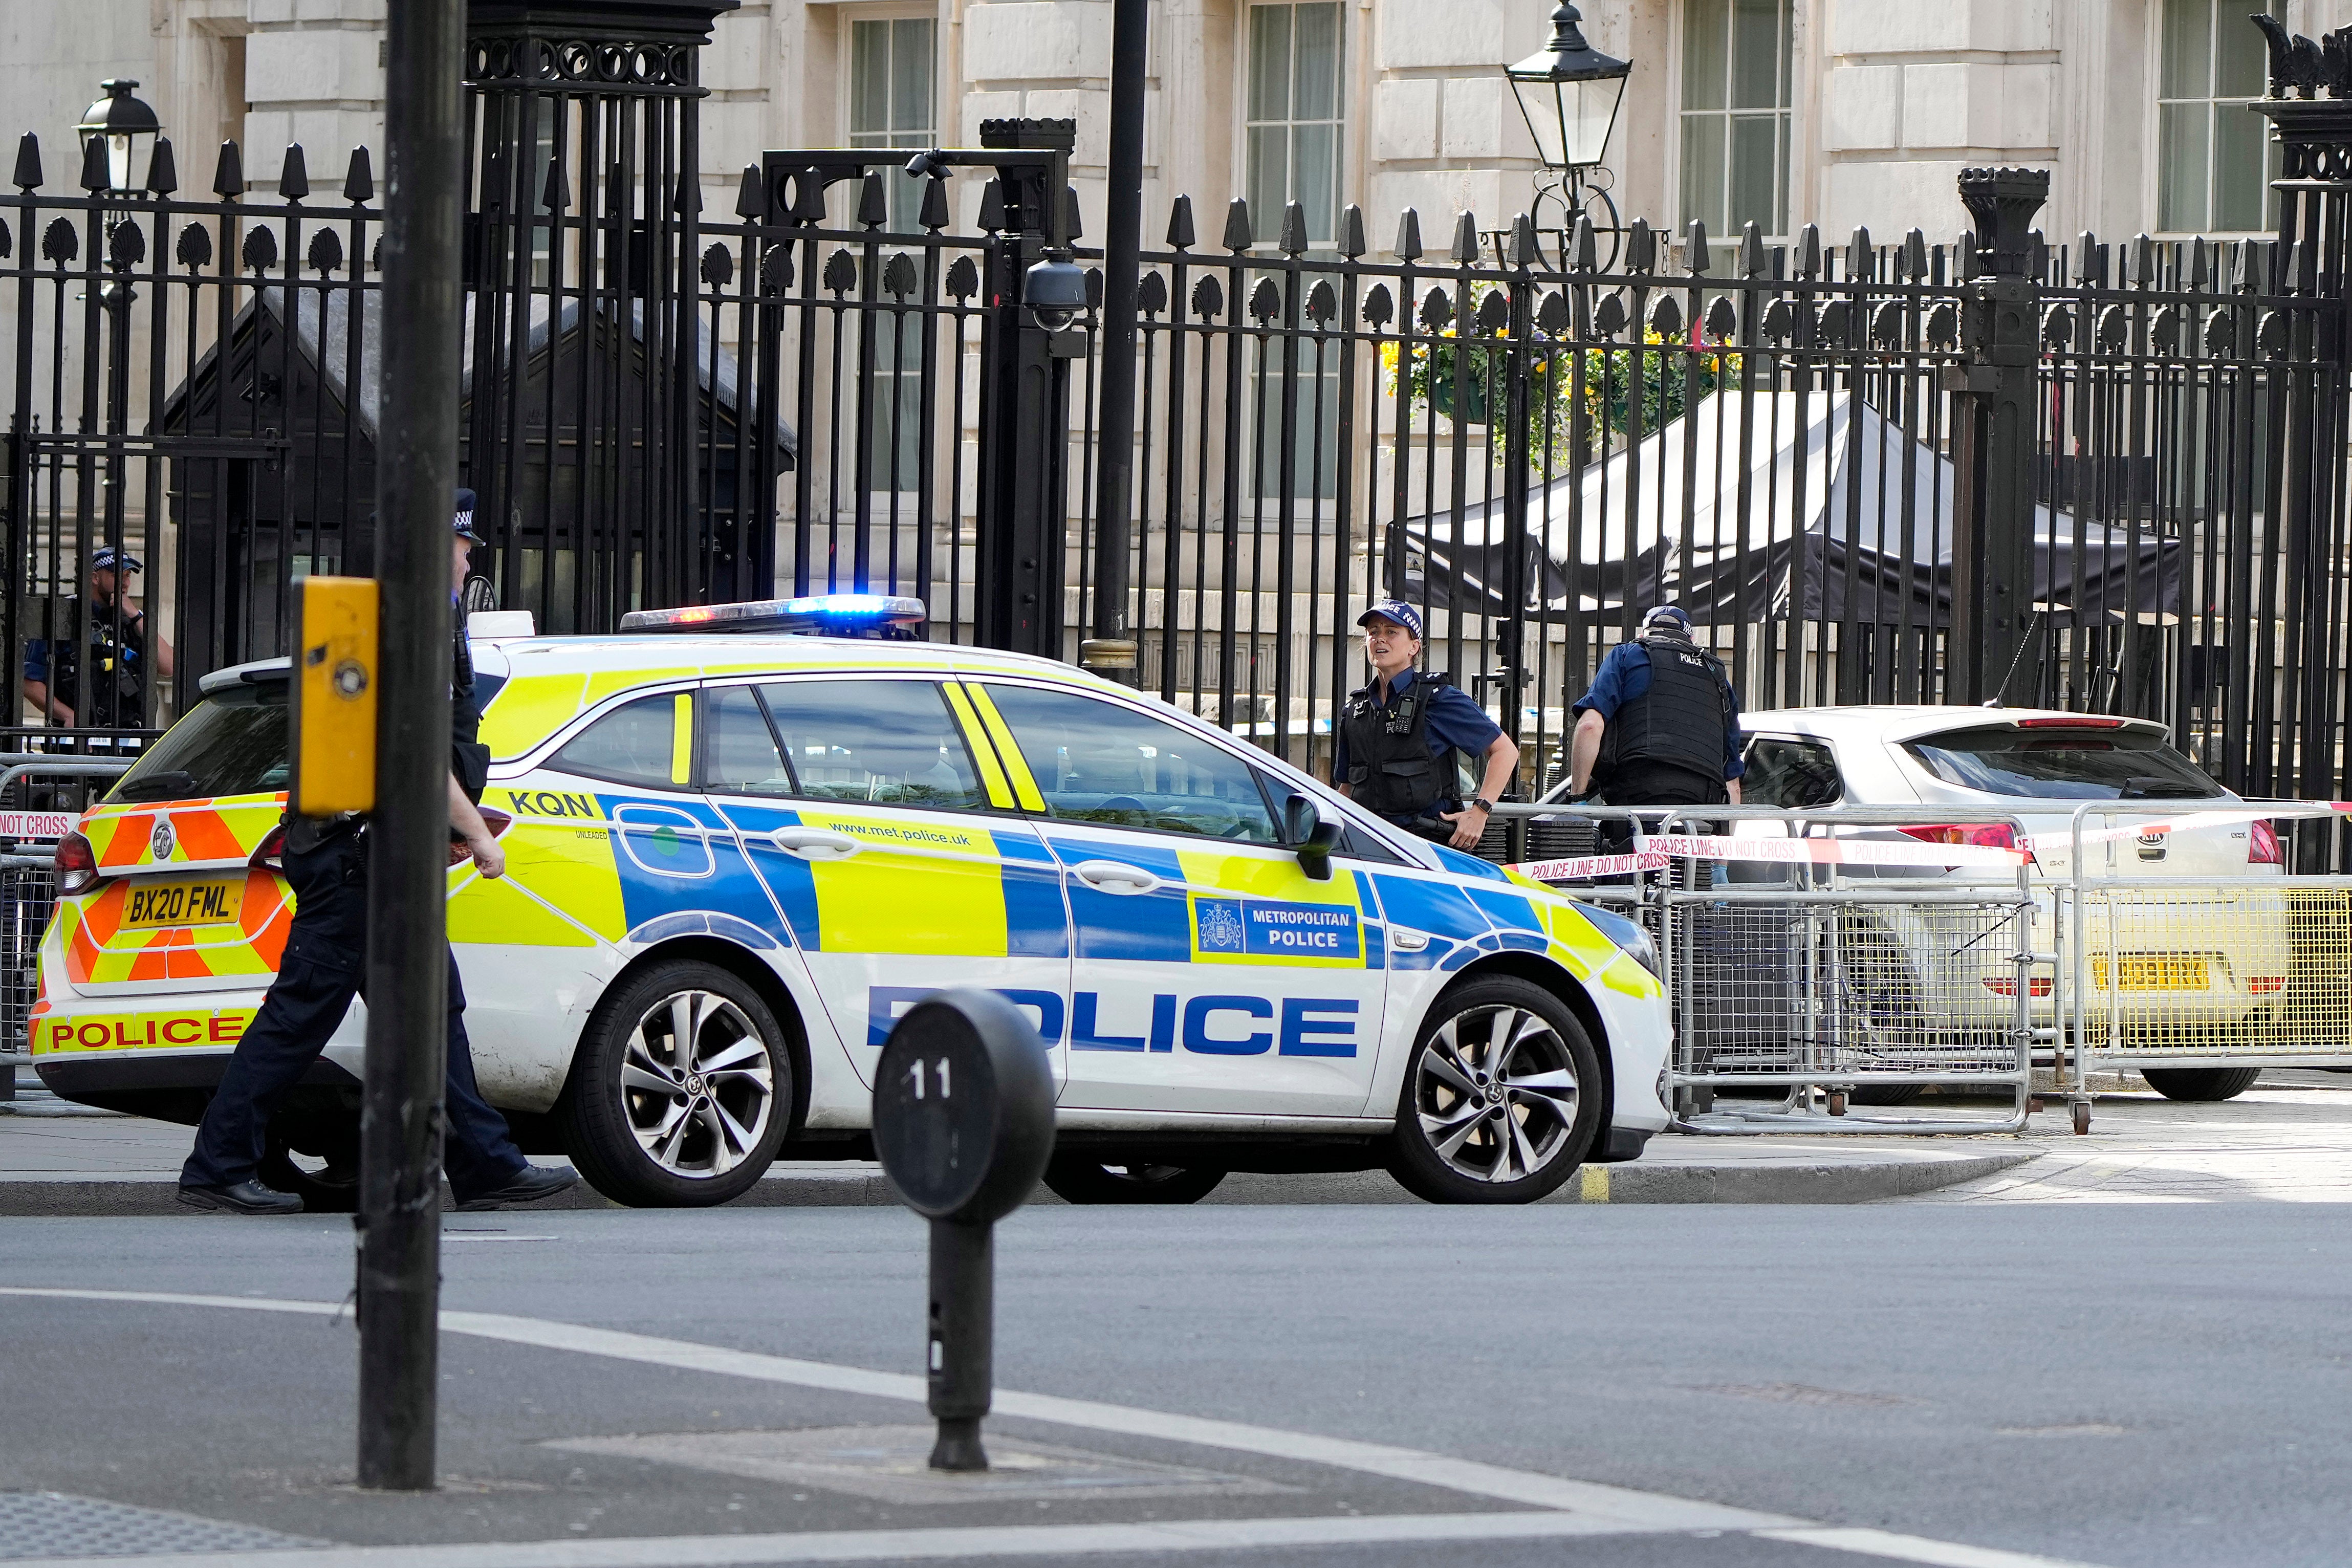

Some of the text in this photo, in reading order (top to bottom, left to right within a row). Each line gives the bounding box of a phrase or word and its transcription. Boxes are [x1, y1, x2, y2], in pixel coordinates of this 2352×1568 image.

[1680, 652, 1703, 667] POLICE
[508, 792, 594, 817] KQN
[0, 815, 68, 835] NOT CROSS
[576, 830, 607, 840] UNLEADED
[829, 822, 971, 846] www.met.police.uk
[1649, 838, 1795, 859] POLICE LINE DO NOT CROSS
[1531, 853, 1670, 879] POLICE LINE DO NOT CROSS
[129, 886, 229, 922] BX20 FML
[1253, 910, 1349, 927] METROPOLITAN
[1269, 929, 1338, 948] POLICE
[52, 1016, 244, 1049] POLICE
[909, 1057, 951, 1100] 11
